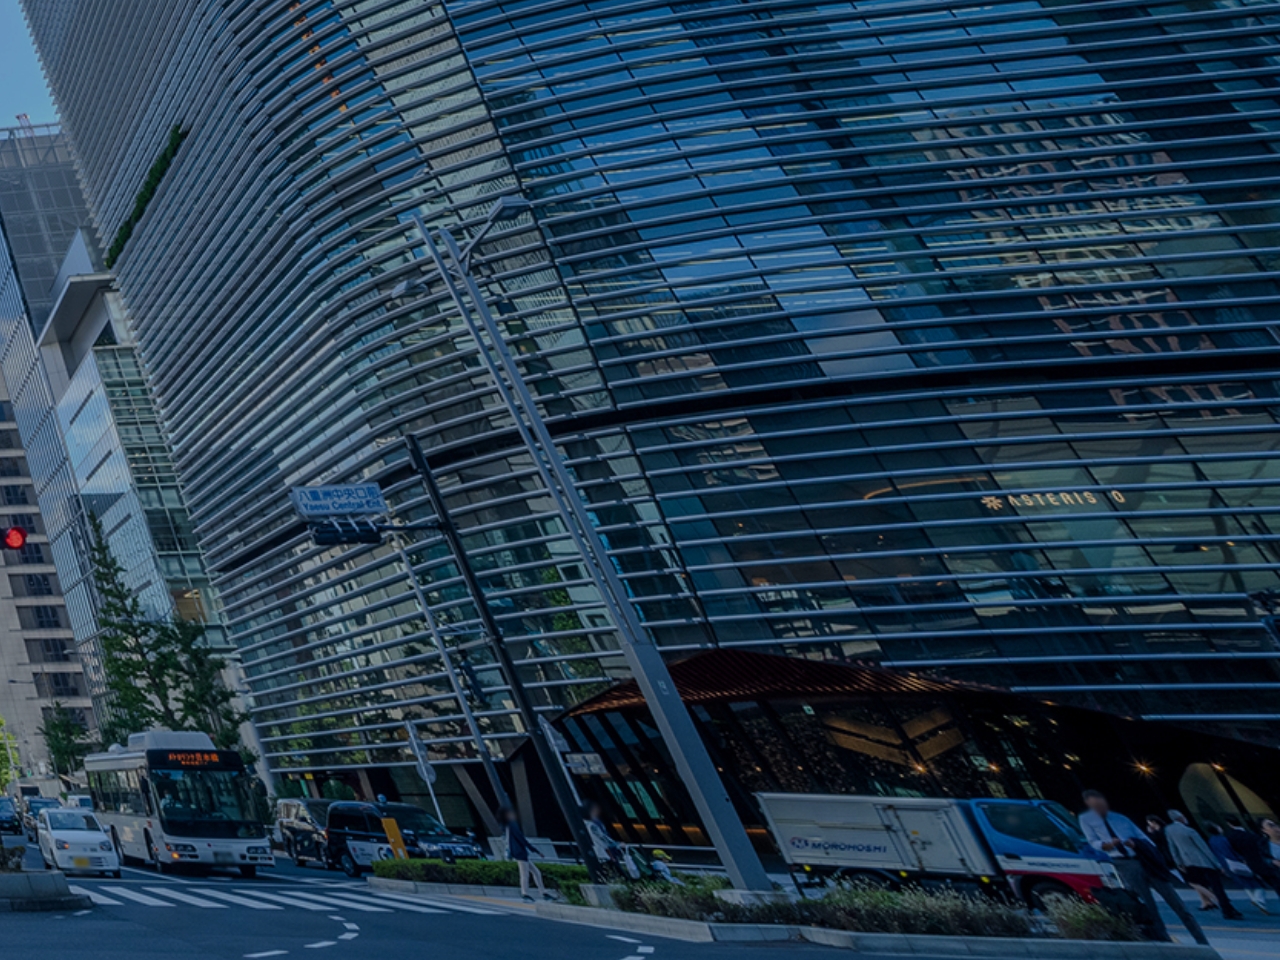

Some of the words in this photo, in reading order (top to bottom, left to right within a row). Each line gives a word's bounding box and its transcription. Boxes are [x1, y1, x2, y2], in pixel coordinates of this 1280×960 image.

[300, 486, 379, 501] 八重洲中央口前
[1007, 490, 1126, 507] ASTERISO
[303, 502, 330, 510] Yaesu
[332, 500, 364, 510] Central
[811, 842, 888, 853] MOROHOSHI
